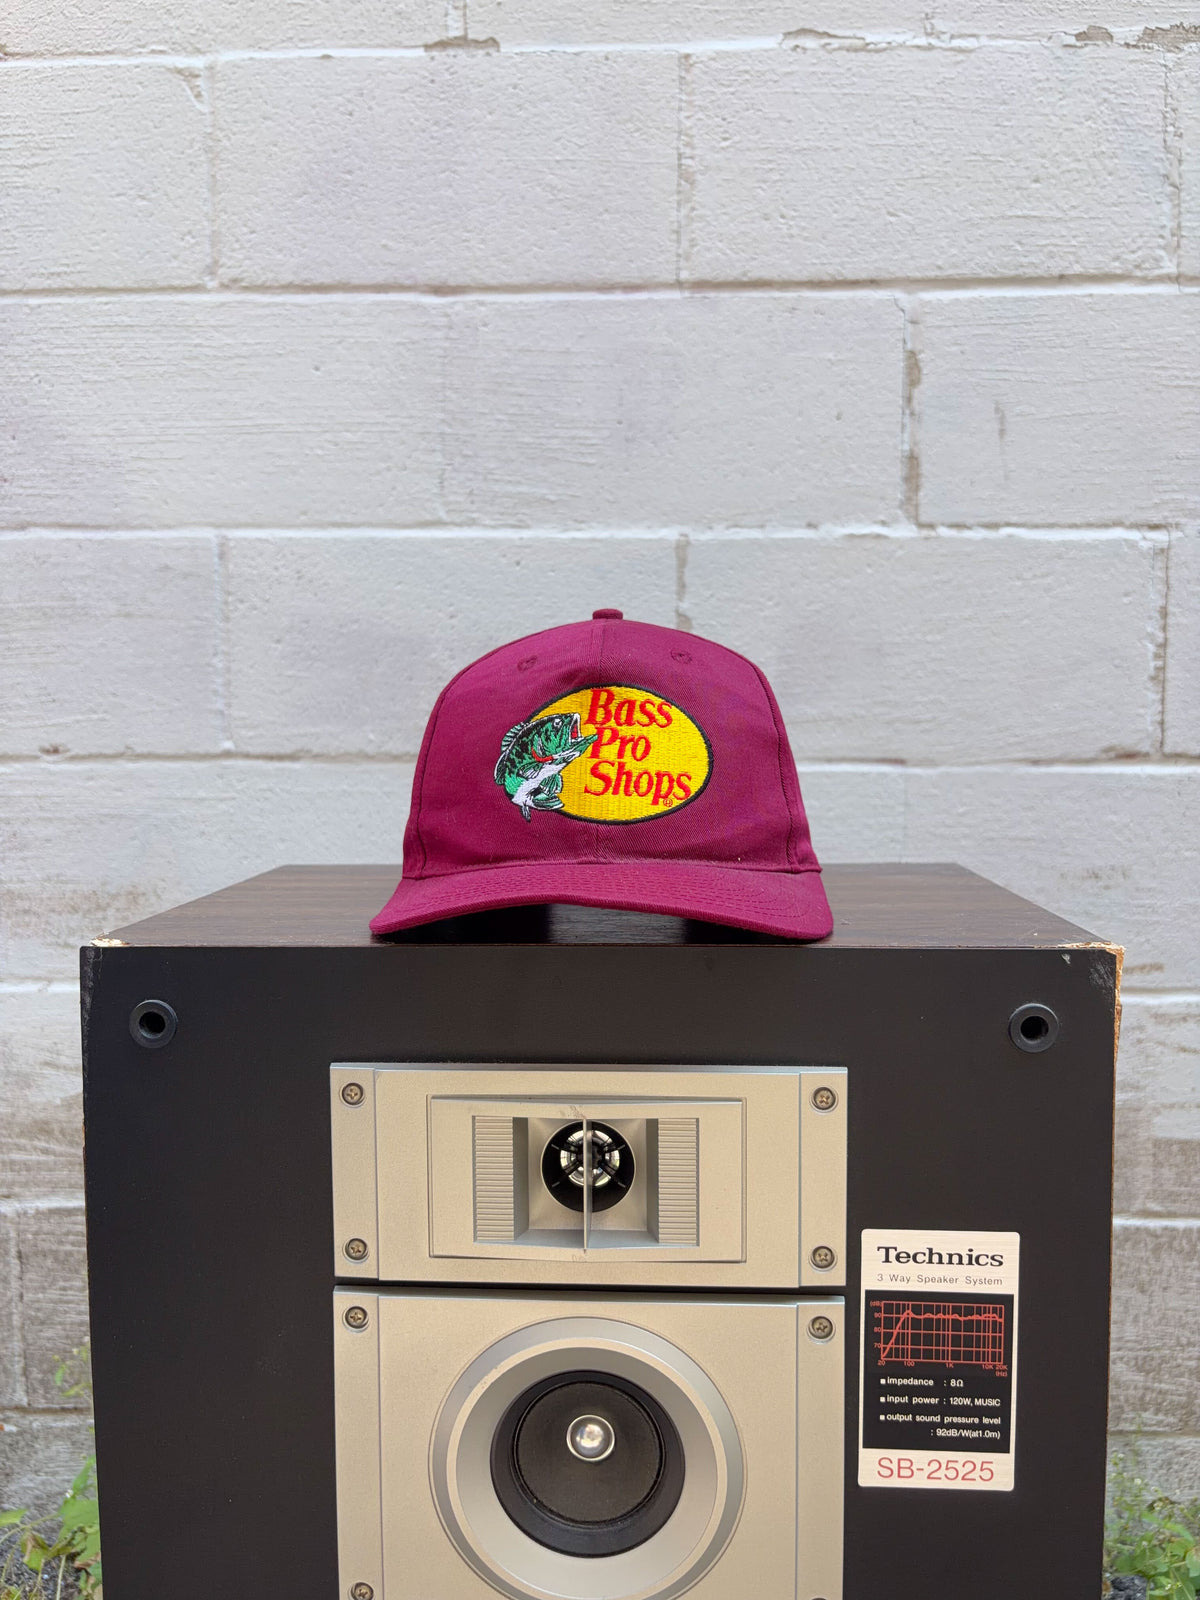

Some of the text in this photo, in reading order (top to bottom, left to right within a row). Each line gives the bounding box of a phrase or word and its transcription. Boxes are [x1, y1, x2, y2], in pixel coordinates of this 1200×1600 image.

[583, 688, 673, 728] Bass
[587, 725, 651, 762] Pro
[584, 760, 692, 806] Shops
[877, 1246, 1004, 1267] Technics
[877, 1273, 1003, 1286] 3 Way Speaker System
[887, 1376, 934, 1386] impedance
[886, 1394, 909, 1404] input
[912, 1397, 940, 1405] power
[974, 1398, 1001, 1407] MUSIC
[886, 1414, 1002, 1425] output sound pressure level
[877, 1457, 994, 1482] SB-2525
